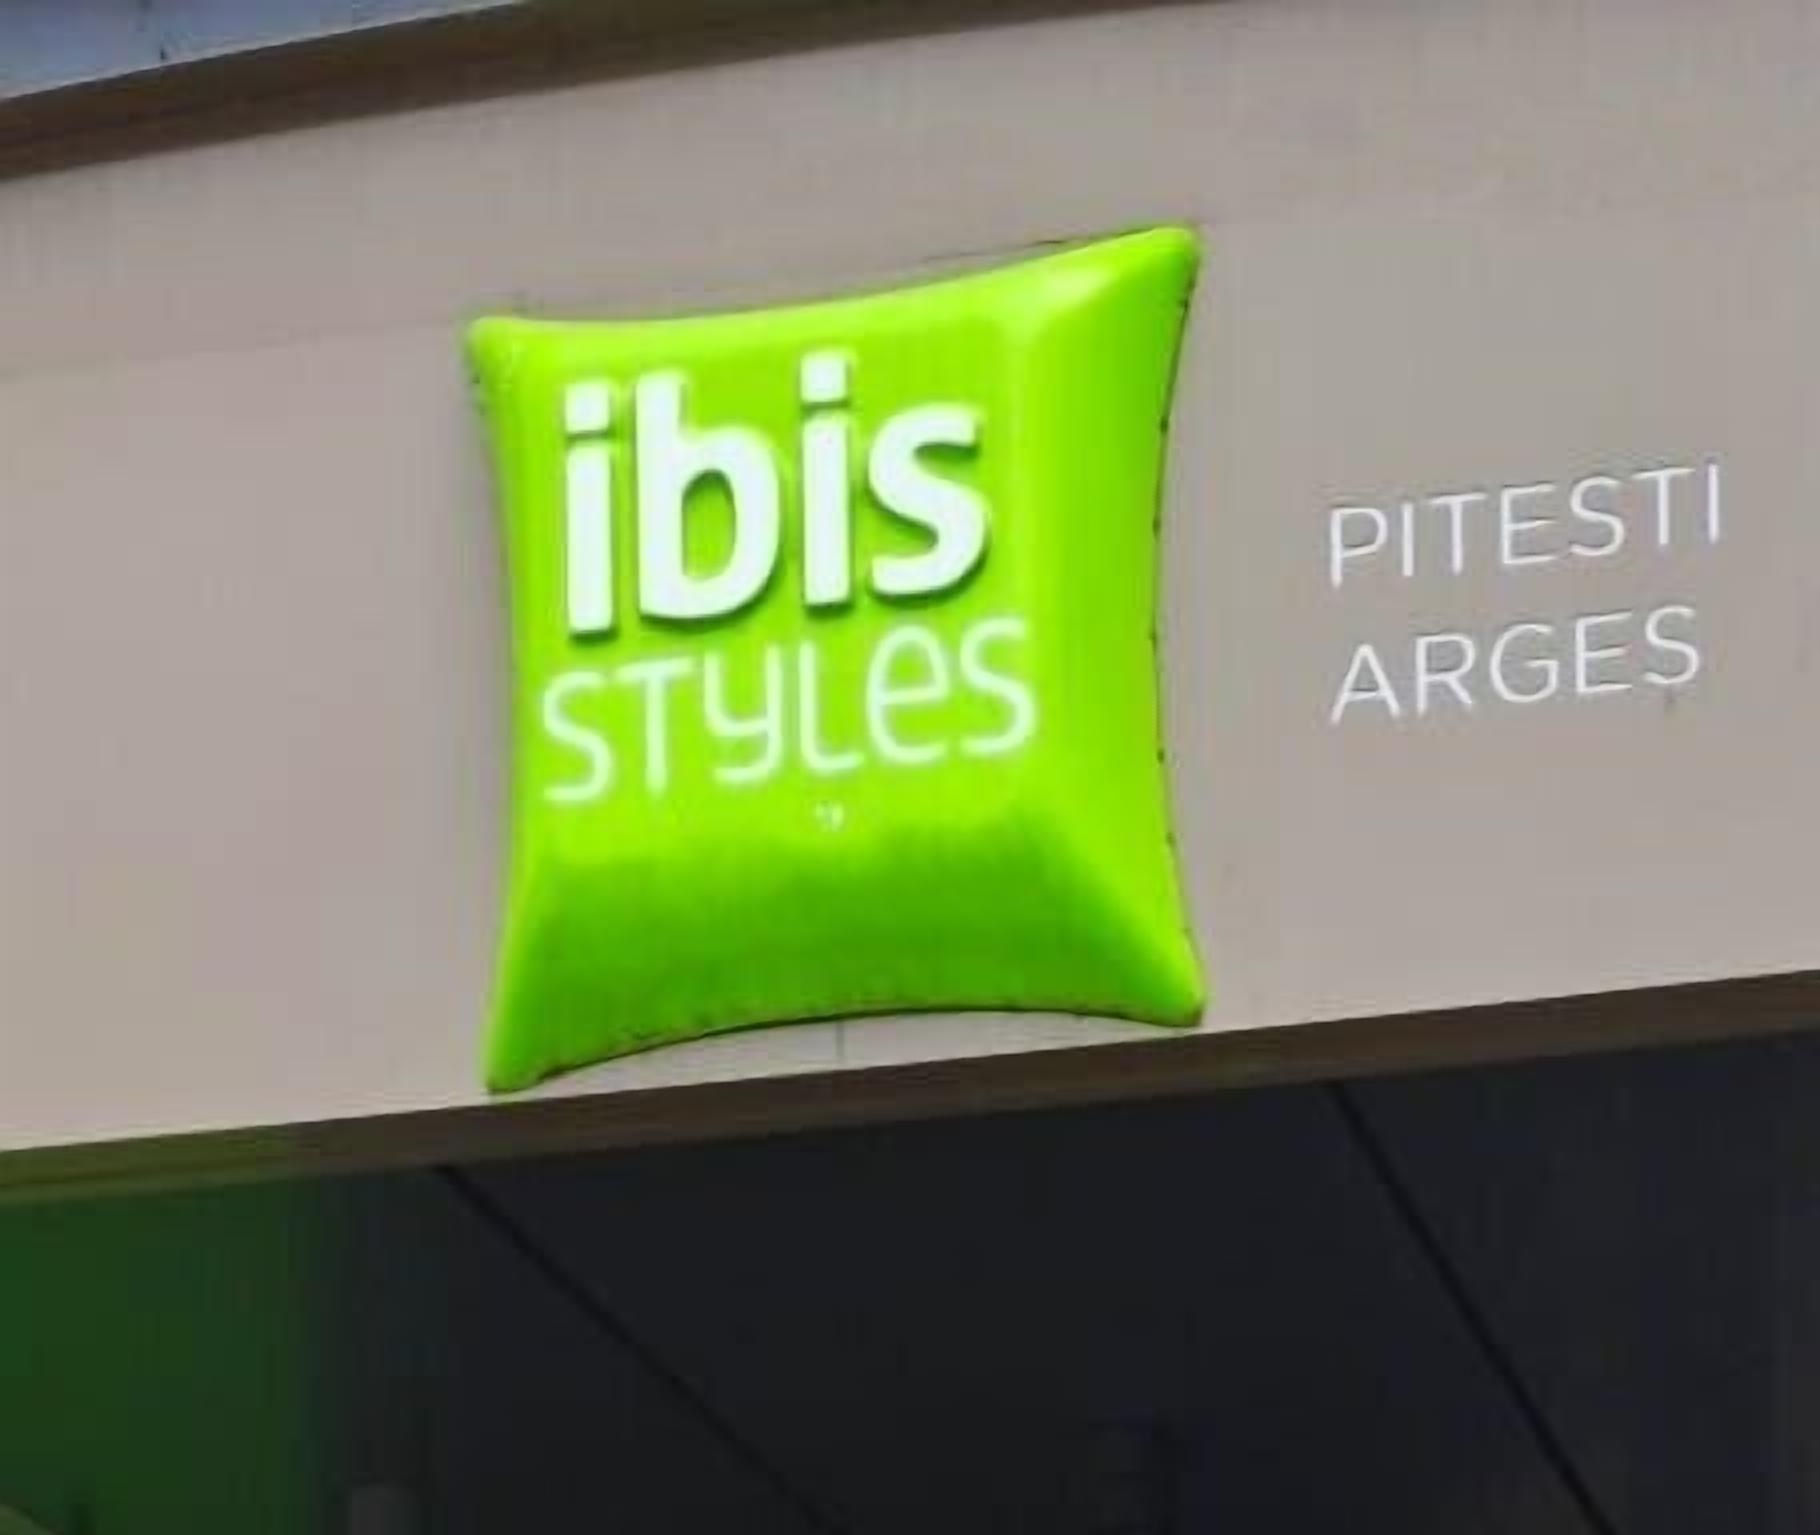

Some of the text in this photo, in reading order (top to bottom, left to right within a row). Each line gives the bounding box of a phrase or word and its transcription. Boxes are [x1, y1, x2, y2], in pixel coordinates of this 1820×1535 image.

[562, 349, 991, 638] ibis
[1327, 462, 1721, 588] PITESTI
[1328, 603, 1701, 725] ARGES
